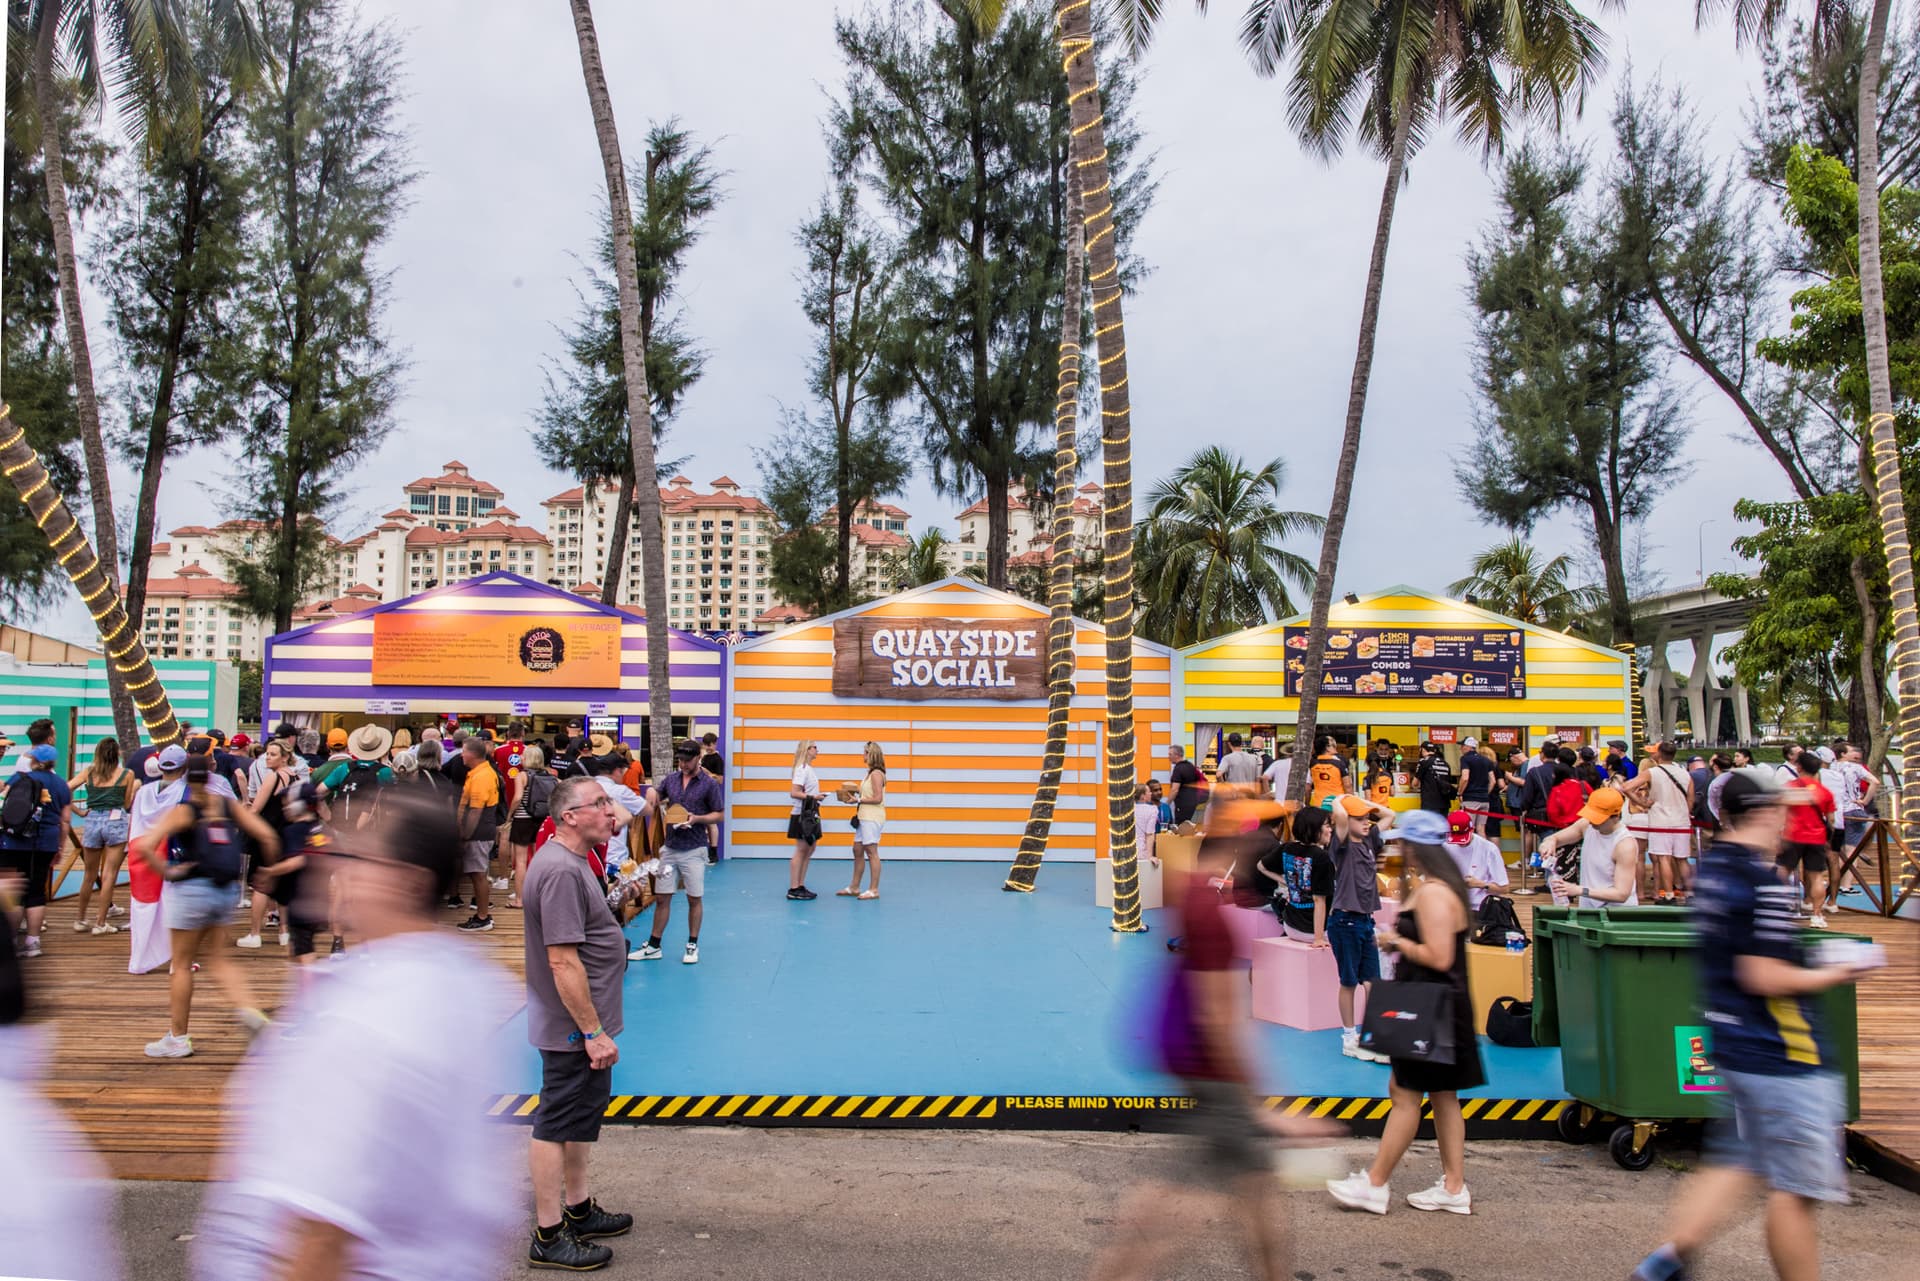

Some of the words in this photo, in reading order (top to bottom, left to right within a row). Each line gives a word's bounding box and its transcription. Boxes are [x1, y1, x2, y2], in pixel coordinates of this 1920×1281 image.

[526, 631, 551, 648] PITSTOP
[872, 629, 1036, 658] QUAYSIDE
[526, 661, 557, 670] BURGERS
[892, 659, 1016, 687] SOCIAL
[1323, 672, 1334, 684] A
[1389, 672, 1399, 684] B
[1462, 673, 1473, 685] C
[1492, 731, 1514, 739] ORDER
[1005, 1097, 1064, 1109] PLEASE
[1068, 1097, 1108, 1109] MIND
[1112, 1097, 1156, 1109] YOUR
[1159, 1097, 1198, 1109] STEP
